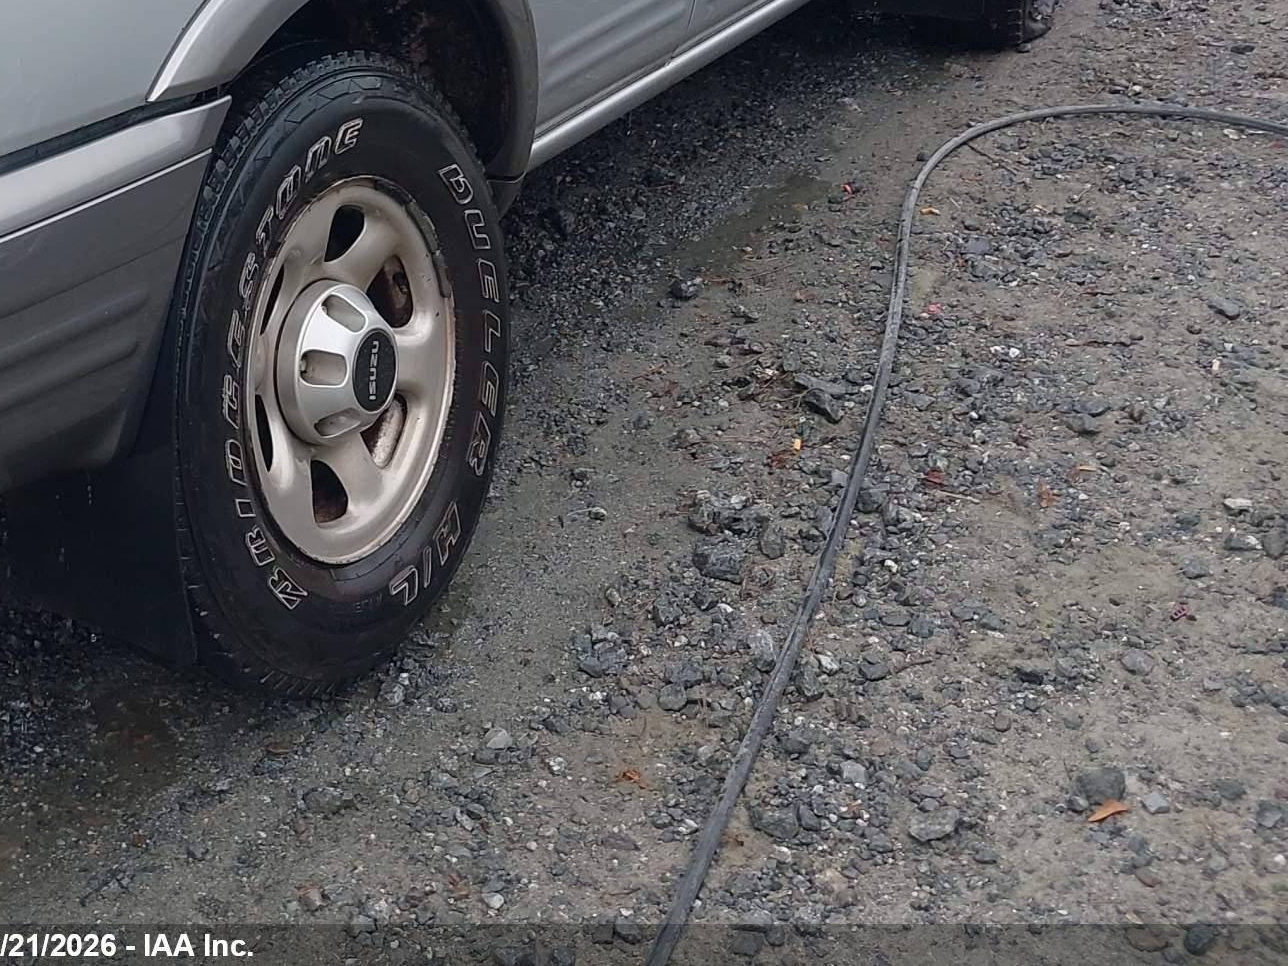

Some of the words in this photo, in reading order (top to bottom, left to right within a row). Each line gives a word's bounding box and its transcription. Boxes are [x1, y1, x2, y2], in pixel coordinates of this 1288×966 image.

[221, 117, 364, 611] BRIDGESTONE
[368, 340, 380, 400] ISUZU
[437, 163, 502, 477] DUELER
[389, 500, 461, 606] H/L
